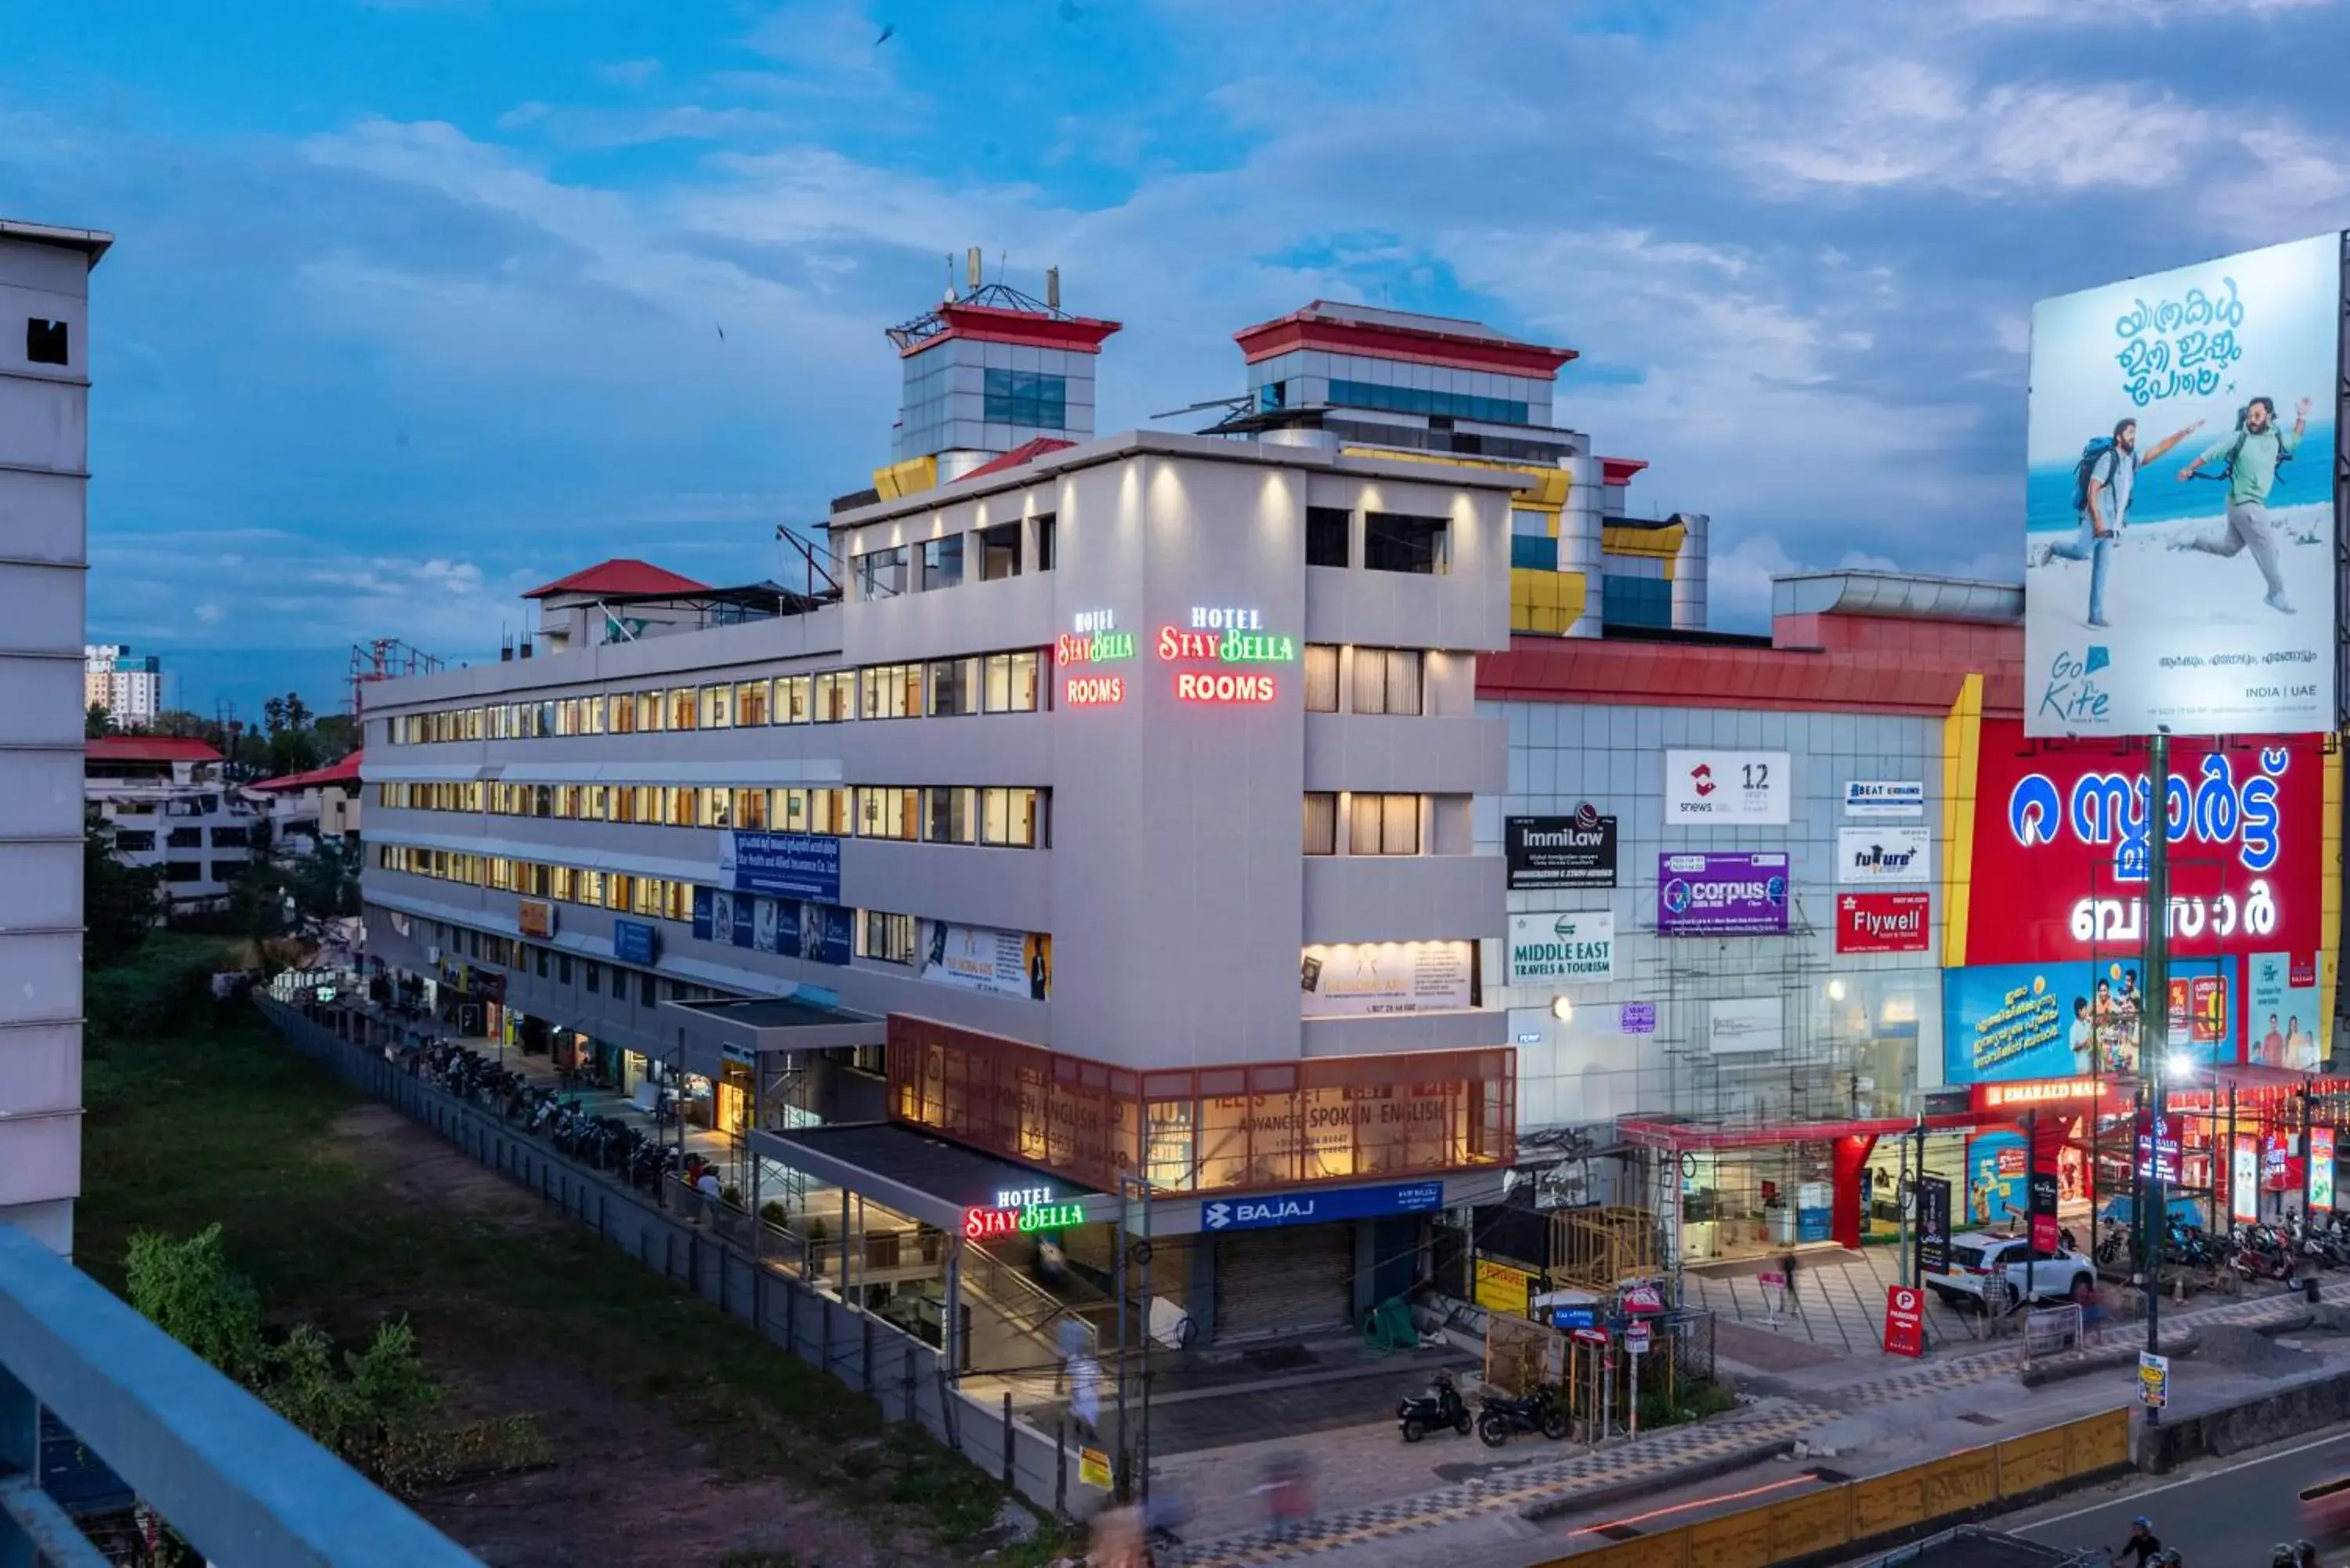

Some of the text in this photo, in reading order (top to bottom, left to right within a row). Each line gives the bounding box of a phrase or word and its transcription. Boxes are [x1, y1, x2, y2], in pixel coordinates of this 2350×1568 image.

[2115, 337, 2170, 377] ഇനി
[1076, 609, 1116, 632] HOTEL
[1192, 607, 1262, 630] HOTEL
[2052, 651, 2082, 679] Go
[1068, 677, 1122, 703] ROOMS
[1179, 674, 1273, 700] ROOMS
[2246, 686, 2280, 698] INDIA
[2291, 685, 2317, 696] UAE
[2039, 681, 2109, 721] Kite
[1742, 764, 1769, 789] 12
[1523, 829, 1603, 847] ImmiLaw
[1692, 883, 1764, 905] corpus
[1854, 910, 1919, 936] Flywell
[1515, 941, 1610, 962] MIDDLE EAST
[1515, 962, 1610, 975] TRAVELS & TOURISM
[1310, 1105, 1371, 1128] SPOKN
[1381, 1100, 1443, 1123] ENLISH
[998, 1187, 1053, 1207] HOTEL
[1237, 1200, 1314, 1221] BAJAJ
[1901, 1293, 1911, 1306] P
